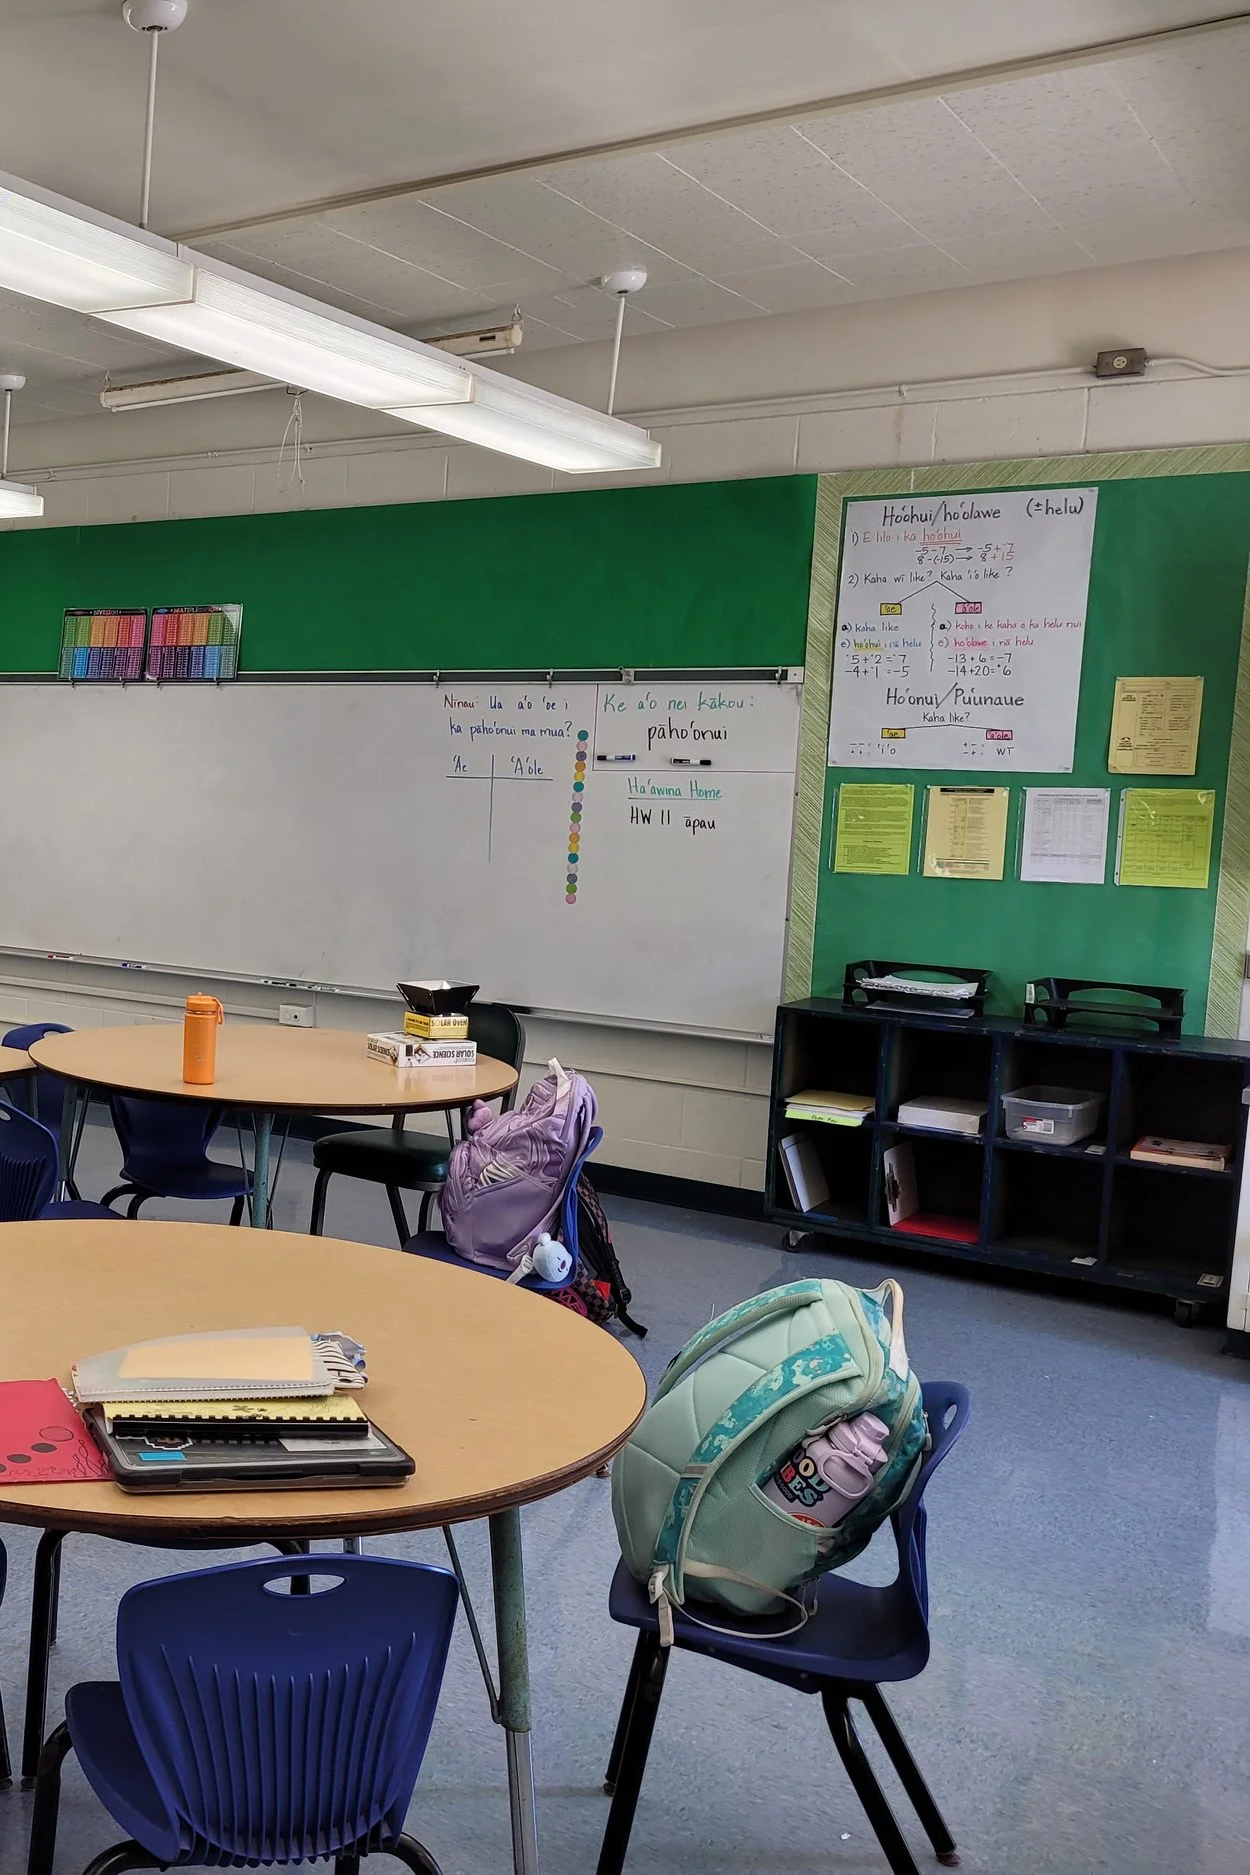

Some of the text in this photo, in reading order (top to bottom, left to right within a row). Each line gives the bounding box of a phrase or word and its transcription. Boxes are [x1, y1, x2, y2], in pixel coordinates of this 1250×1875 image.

[851, 532, 859, 546] 1)
[862, 532, 871, 543] E
[876, 531, 891, 543] lilo
[904, 529, 916, 541] ka
[848, 575, 859, 588] 2)
[864, 571, 887, 584] Kaha
[940, 569, 963, 582] Kaha
[983, 568, 1000, 579] like
[841, 622, 900, 633] a) kaha like
[939, 620, 952, 631] a)
[984, 621, 993, 629] ke
[997, 619, 1017, 629] kaha
[1029, 619, 1039, 630] ka
[1043, 618, 1062, 629] helu
[1066, 621, 1082, 629] nui
[841, 639, 851, 649] e)
[902, 638, 921, 648] helu
[938, 637, 949, 648] e)
[1015, 635, 1034, 647] helu
[490, 695, 503, 710] Ua
[604, 693, 627, 713] Ke
[668, 699, 687, 710] nei
[923, 711, 971, 723] Kaha like?
[449, 717, 463, 736] ka
[522, 728, 536, 737] ma
[540, 721, 573, 738] mua?
[690, 780, 722, 799] Home
[630, 806, 652, 825] HW
[431, 1018, 451, 1027] SOLAR
[433, 1050, 475, 1059] SOLAR SCIENCE
